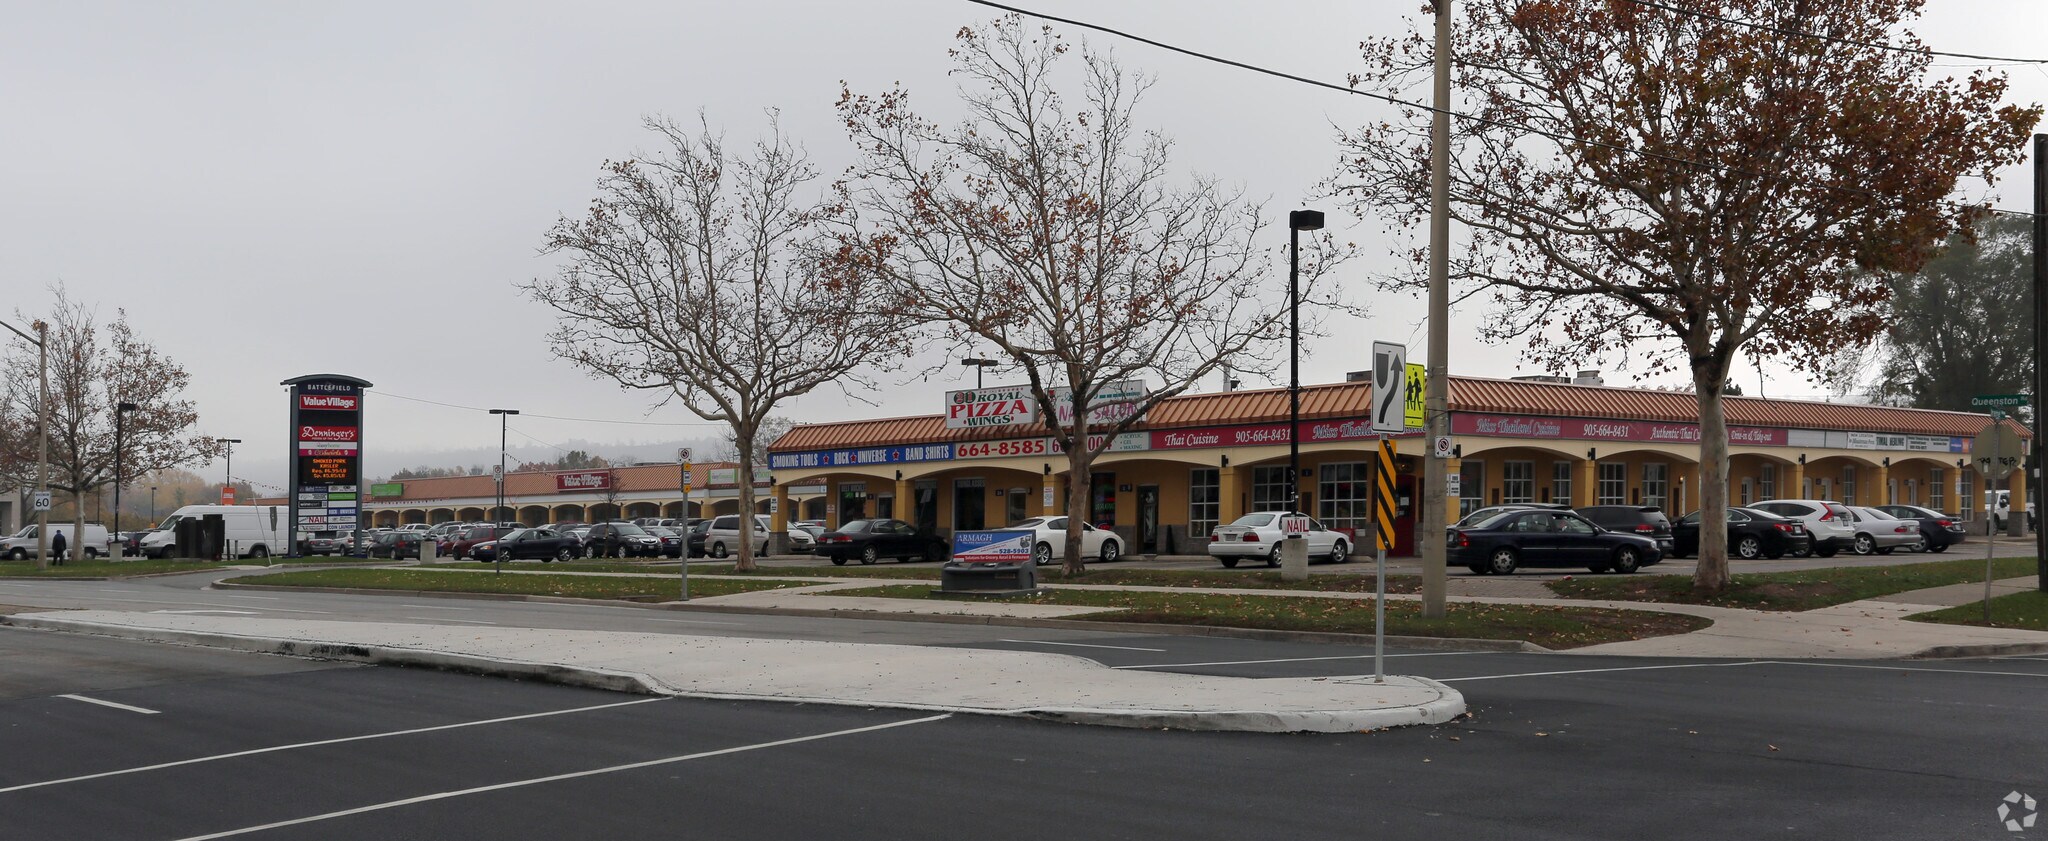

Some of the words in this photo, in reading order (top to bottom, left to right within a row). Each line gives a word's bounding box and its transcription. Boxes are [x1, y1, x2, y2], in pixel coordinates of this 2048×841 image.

[303, 396, 326, 406] Value
[326, 397, 354, 408] Village
[977, 391, 1024, 402] ROYAL
[1971, 397, 2018, 406] Queenston
[950, 400, 1028, 418] PIZZA
[967, 414, 1011, 426] WINGS
[302, 426, 354, 440] Denninger's
[1235, 428, 1292, 443] 905-664-8431
[1312, 424, 1338, 440] Miss
[1583, 423, 1630, 438] 905-664-8431
[1650, 426, 1679, 440] Authentic
[1680, 426, 1693, 440] Thai
[1164, 433, 1184, 446] Thai
[1186, 432, 1219, 446] Cuisine
[958, 440, 1045, 457] 664-8585
[772, 454, 799, 468] SMOKING
[800, 453, 818, 466] TOOLS
[834, 452, 850, 464] ROCK
[857, 449, 886, 463] UNIVERSE
[905, 446, 924, 460] BAND
[925, 444, 950, 460] SHIRTS
[564, 476, 580, 486] Value
[580, 474, 602, 488] Village
[36, 498, 50, 507] 60
[1287, 519, 1310, 532] NAIL
[957, 534, 993, 542] ARMAGH
